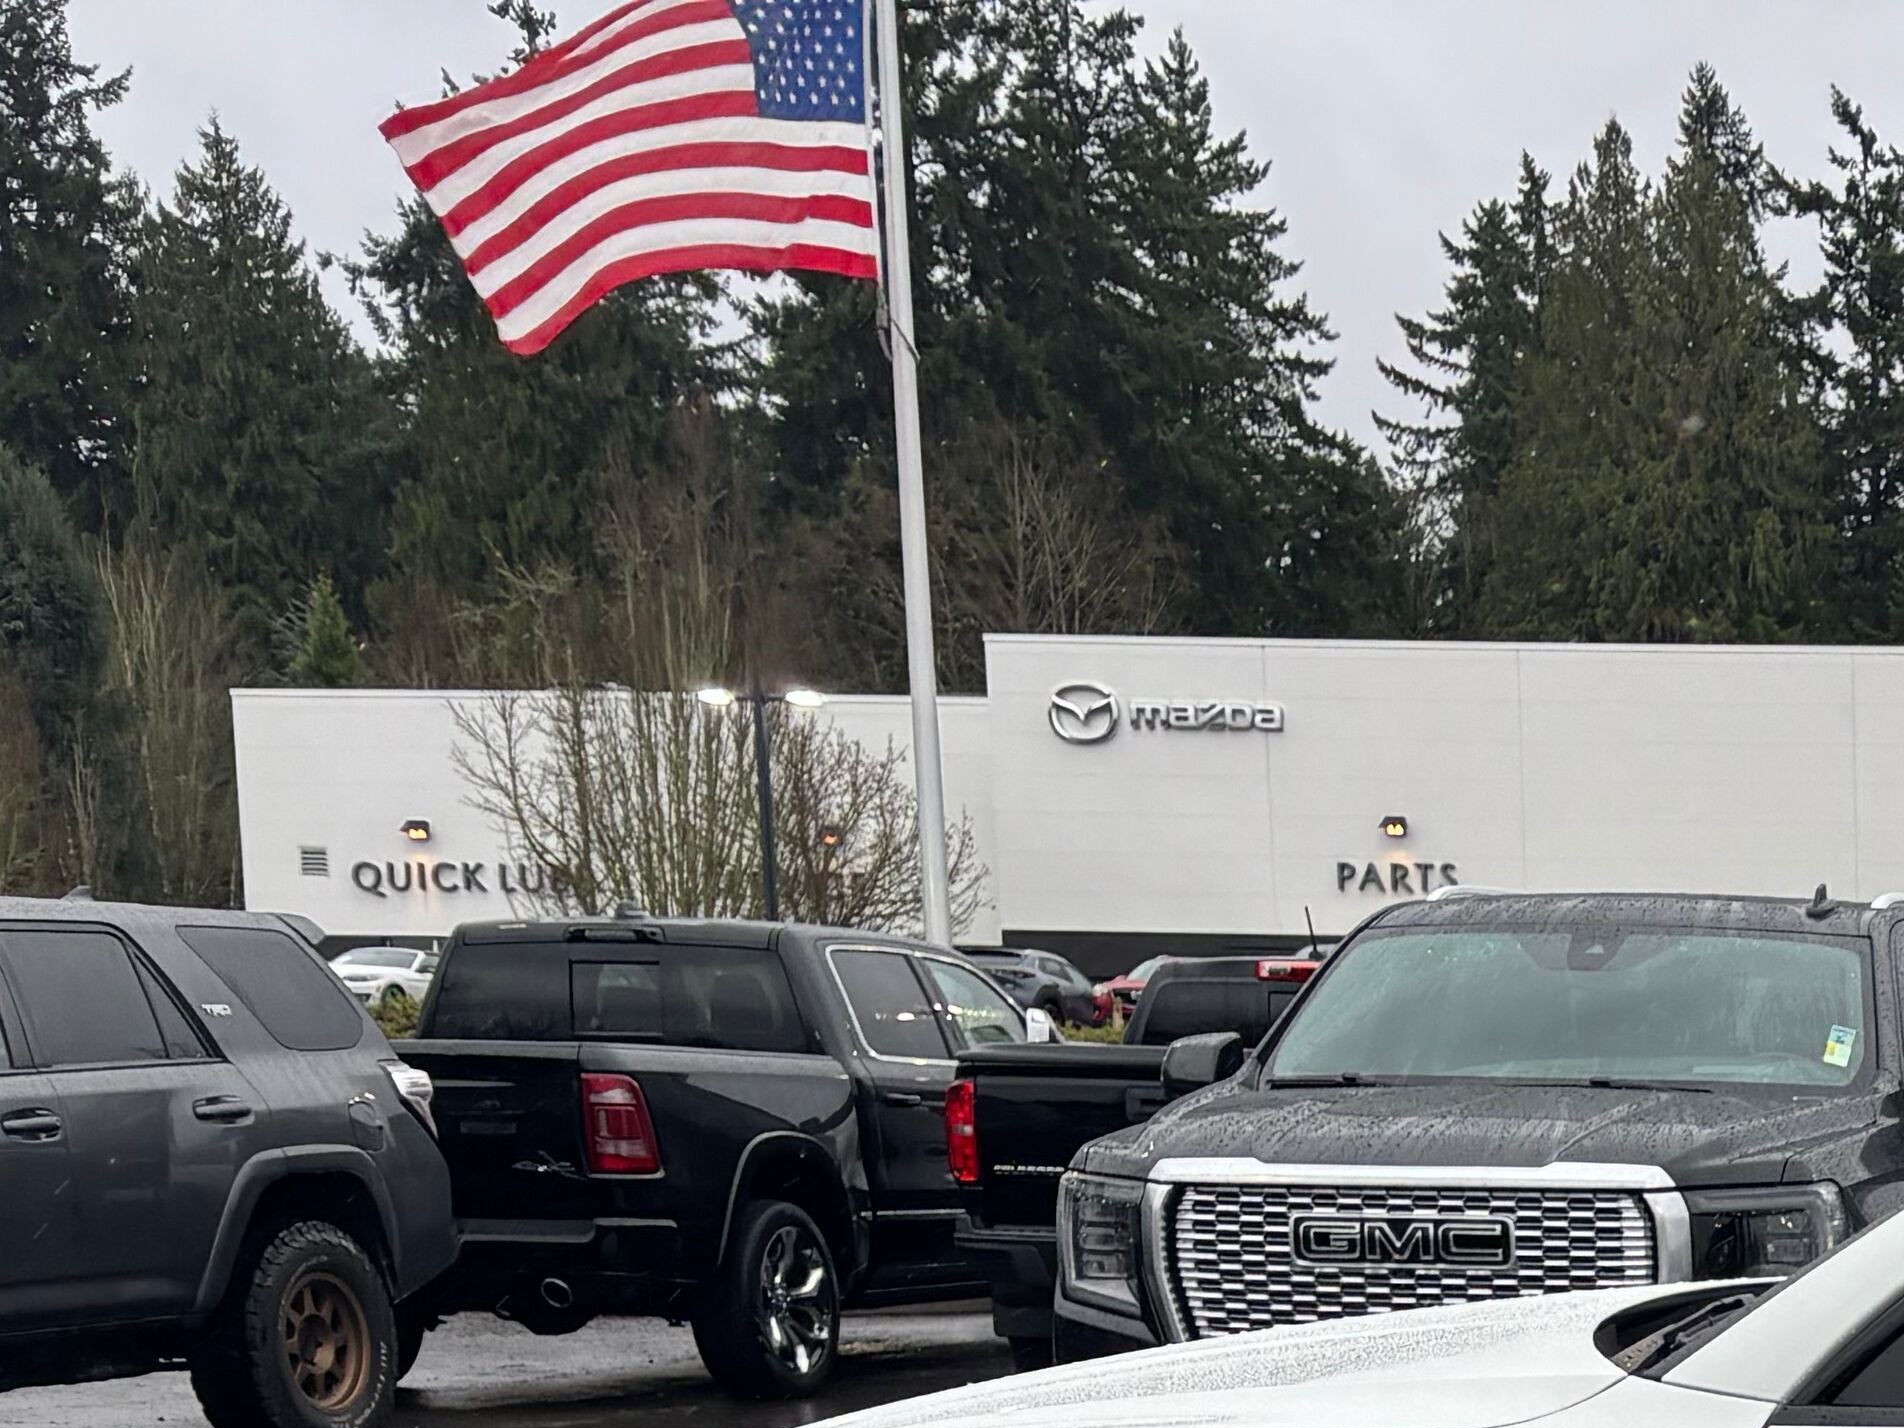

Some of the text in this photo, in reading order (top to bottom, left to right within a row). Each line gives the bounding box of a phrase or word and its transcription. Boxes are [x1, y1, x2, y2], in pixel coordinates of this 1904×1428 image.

[1129, 699, 1285, 733] mazda
[351, 861, 488, 898] QUICK
[1337, 861, 1459, 895] PARTS
[1300, 1220, 1504, 1262] GMC
